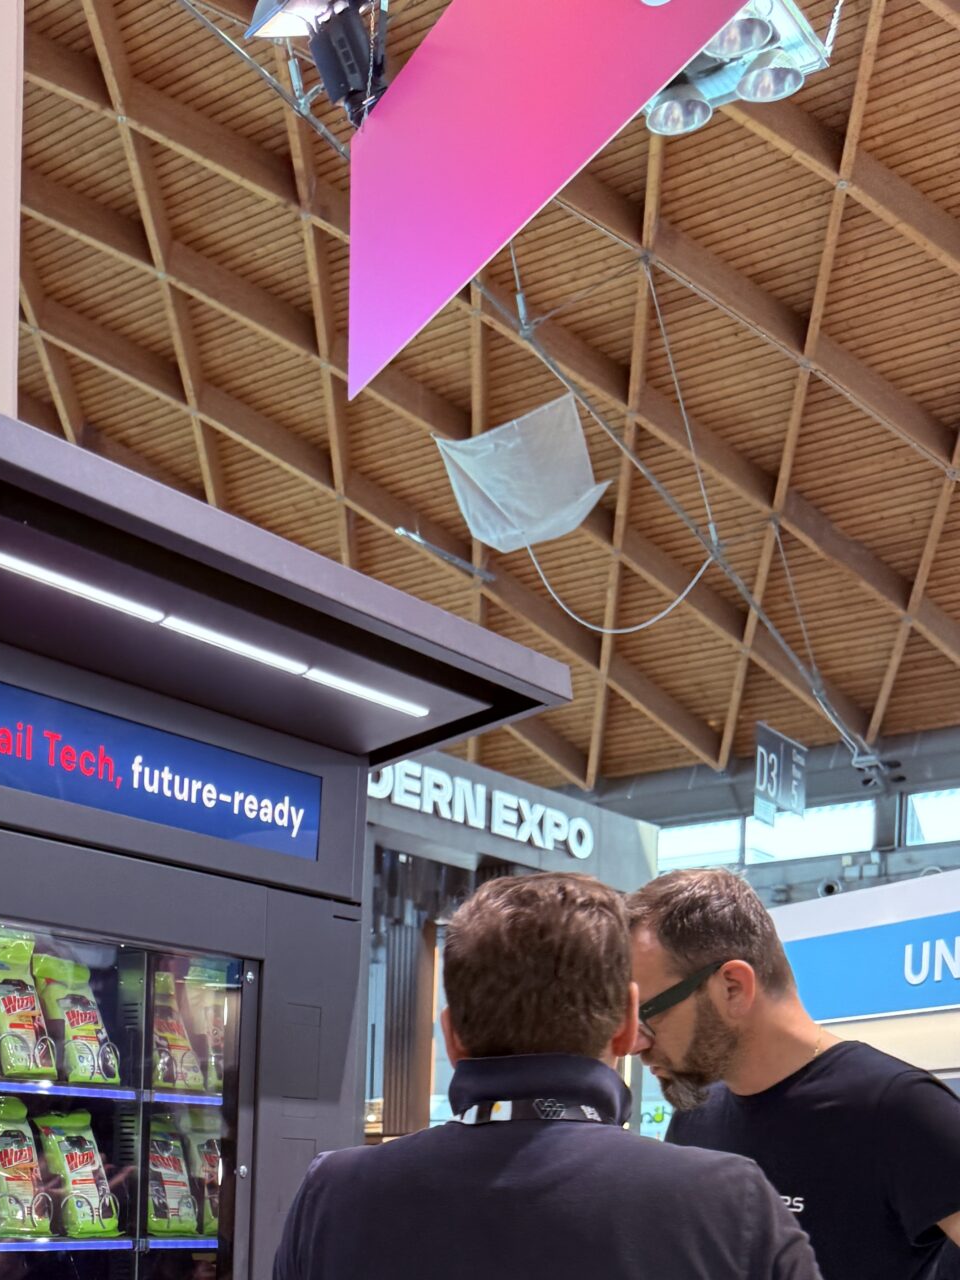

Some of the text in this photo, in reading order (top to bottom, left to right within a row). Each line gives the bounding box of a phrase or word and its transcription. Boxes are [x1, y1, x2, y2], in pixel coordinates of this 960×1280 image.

[43, 731, 122, 789] Tech,
[132, 755, 304, 837] future-ready
[756, 745, 777, 798] D3
[491, 790, 594, 859] EXPO
